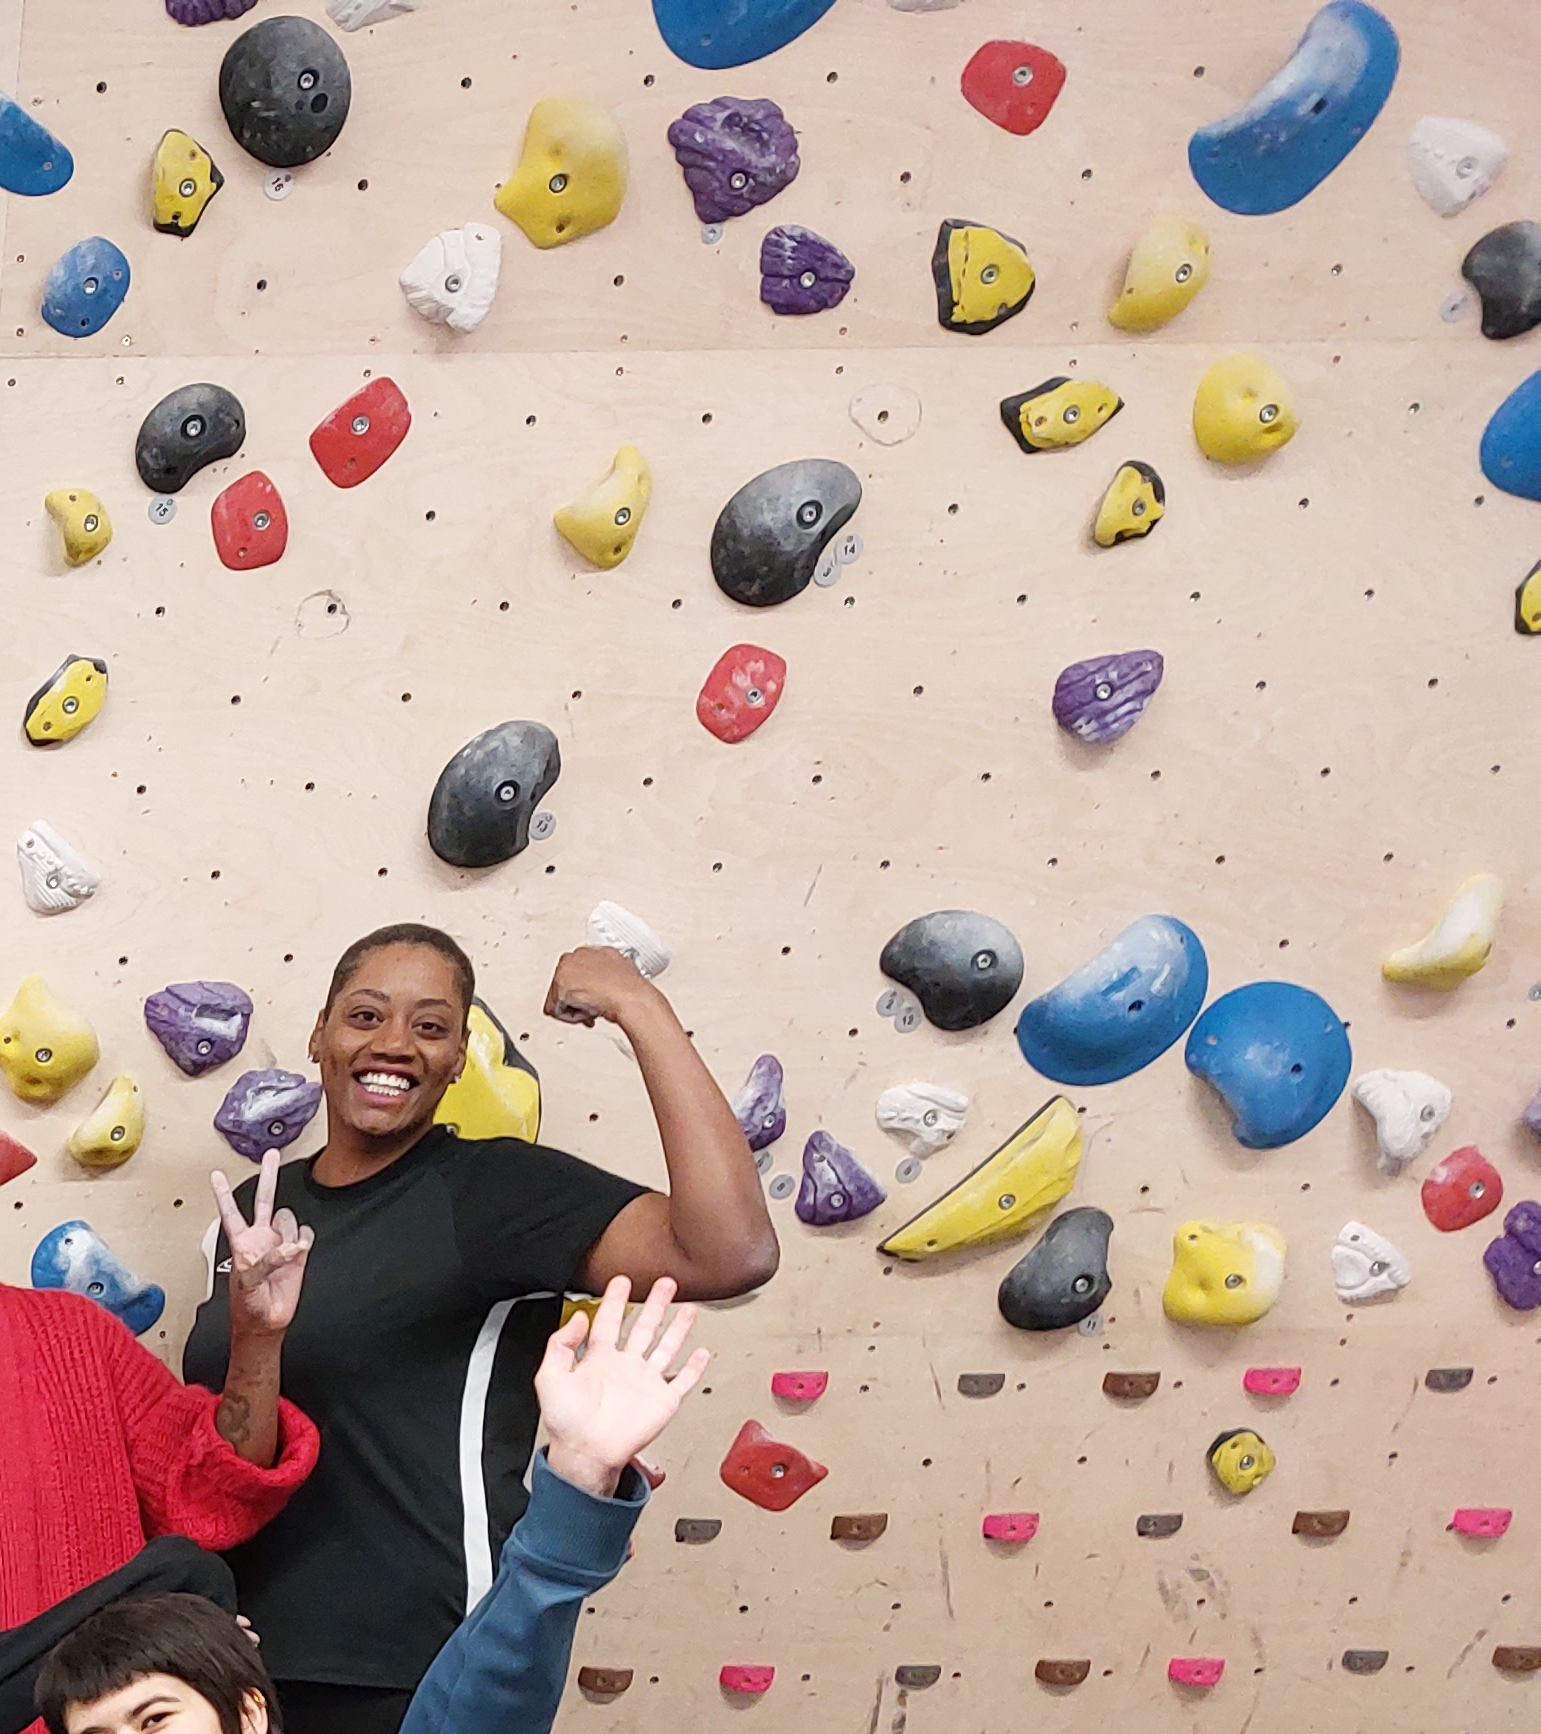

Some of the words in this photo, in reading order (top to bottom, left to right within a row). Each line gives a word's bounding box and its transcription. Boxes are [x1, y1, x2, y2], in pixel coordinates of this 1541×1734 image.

[271, 177, 284, 192] 16
[155, 503, 169, 517] 15
[843, 543, 856, 556] 14
